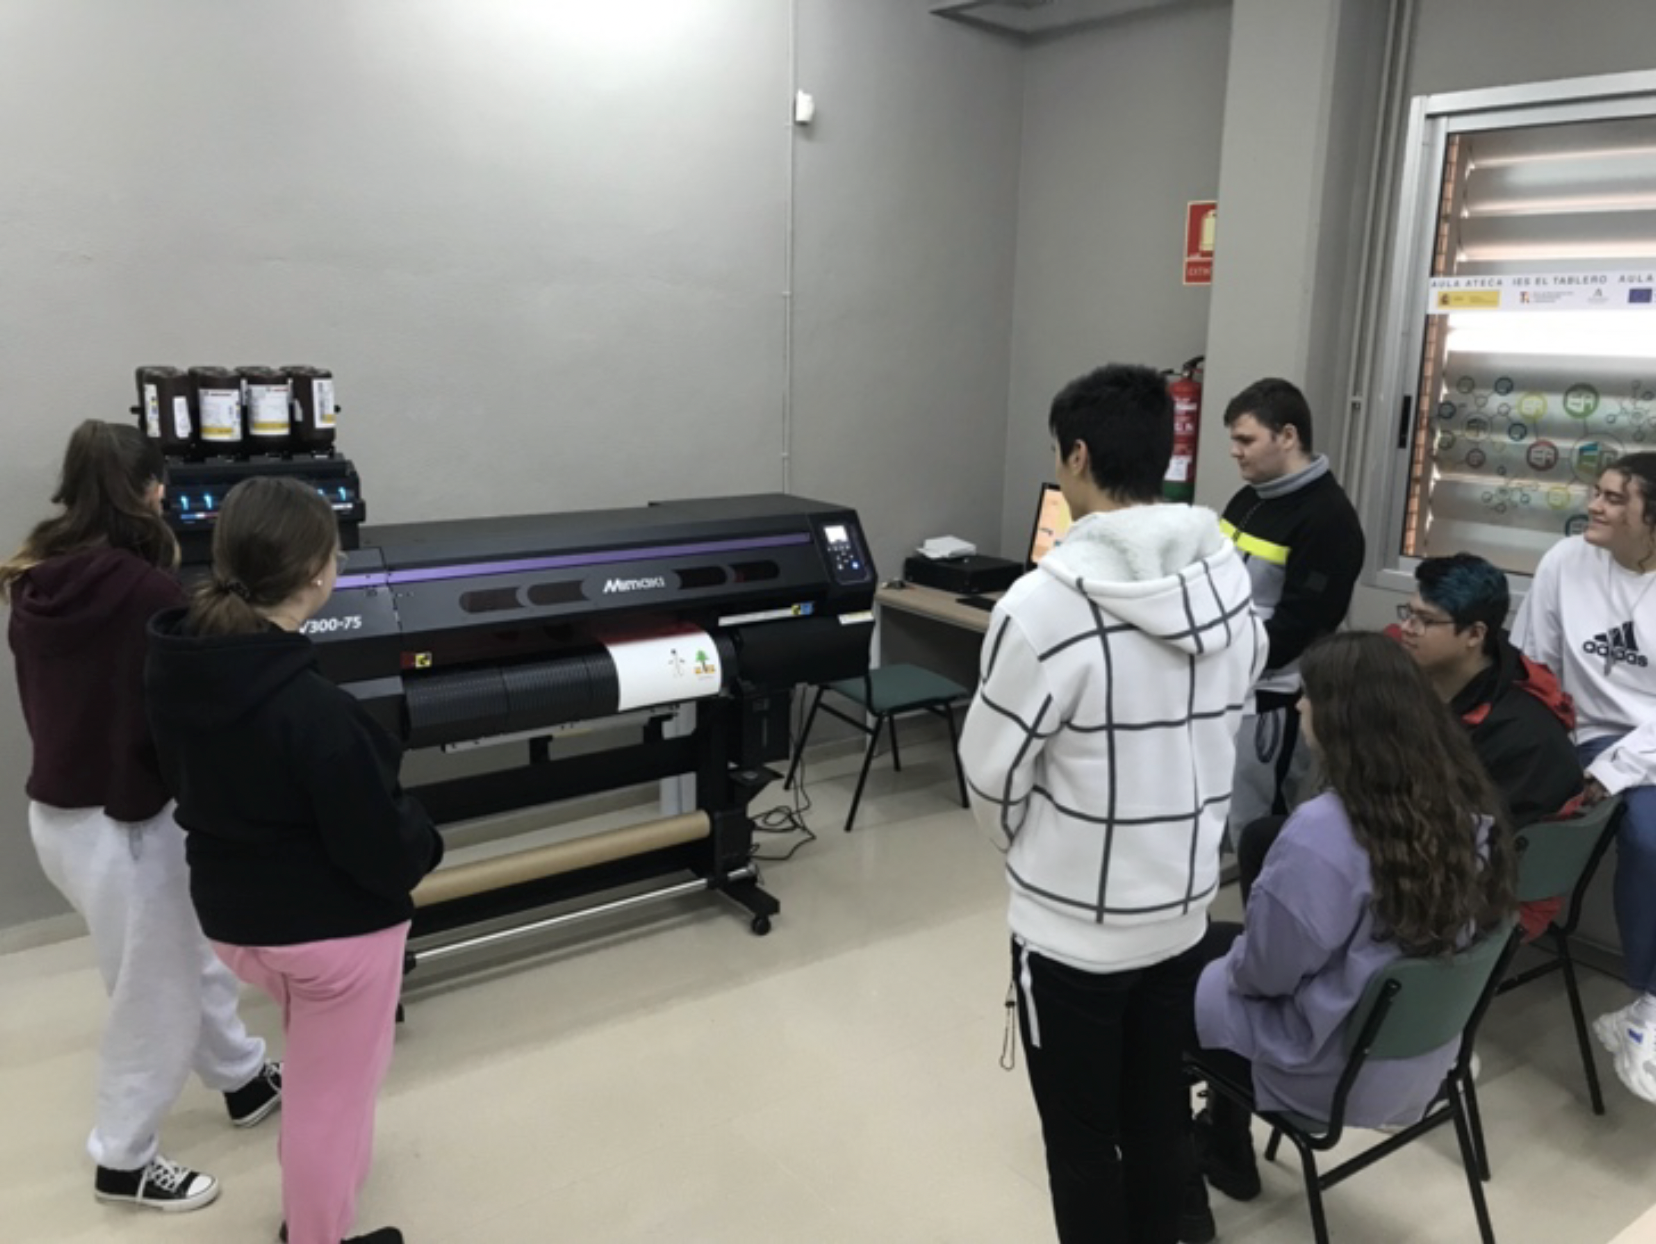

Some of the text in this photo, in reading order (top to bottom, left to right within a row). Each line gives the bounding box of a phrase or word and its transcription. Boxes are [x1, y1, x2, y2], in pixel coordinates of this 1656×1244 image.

[1431, 274, 1654, 288] AULA ATECA IES EL TABLERO AULA
[1583, 640, 1648, 668] adidas
